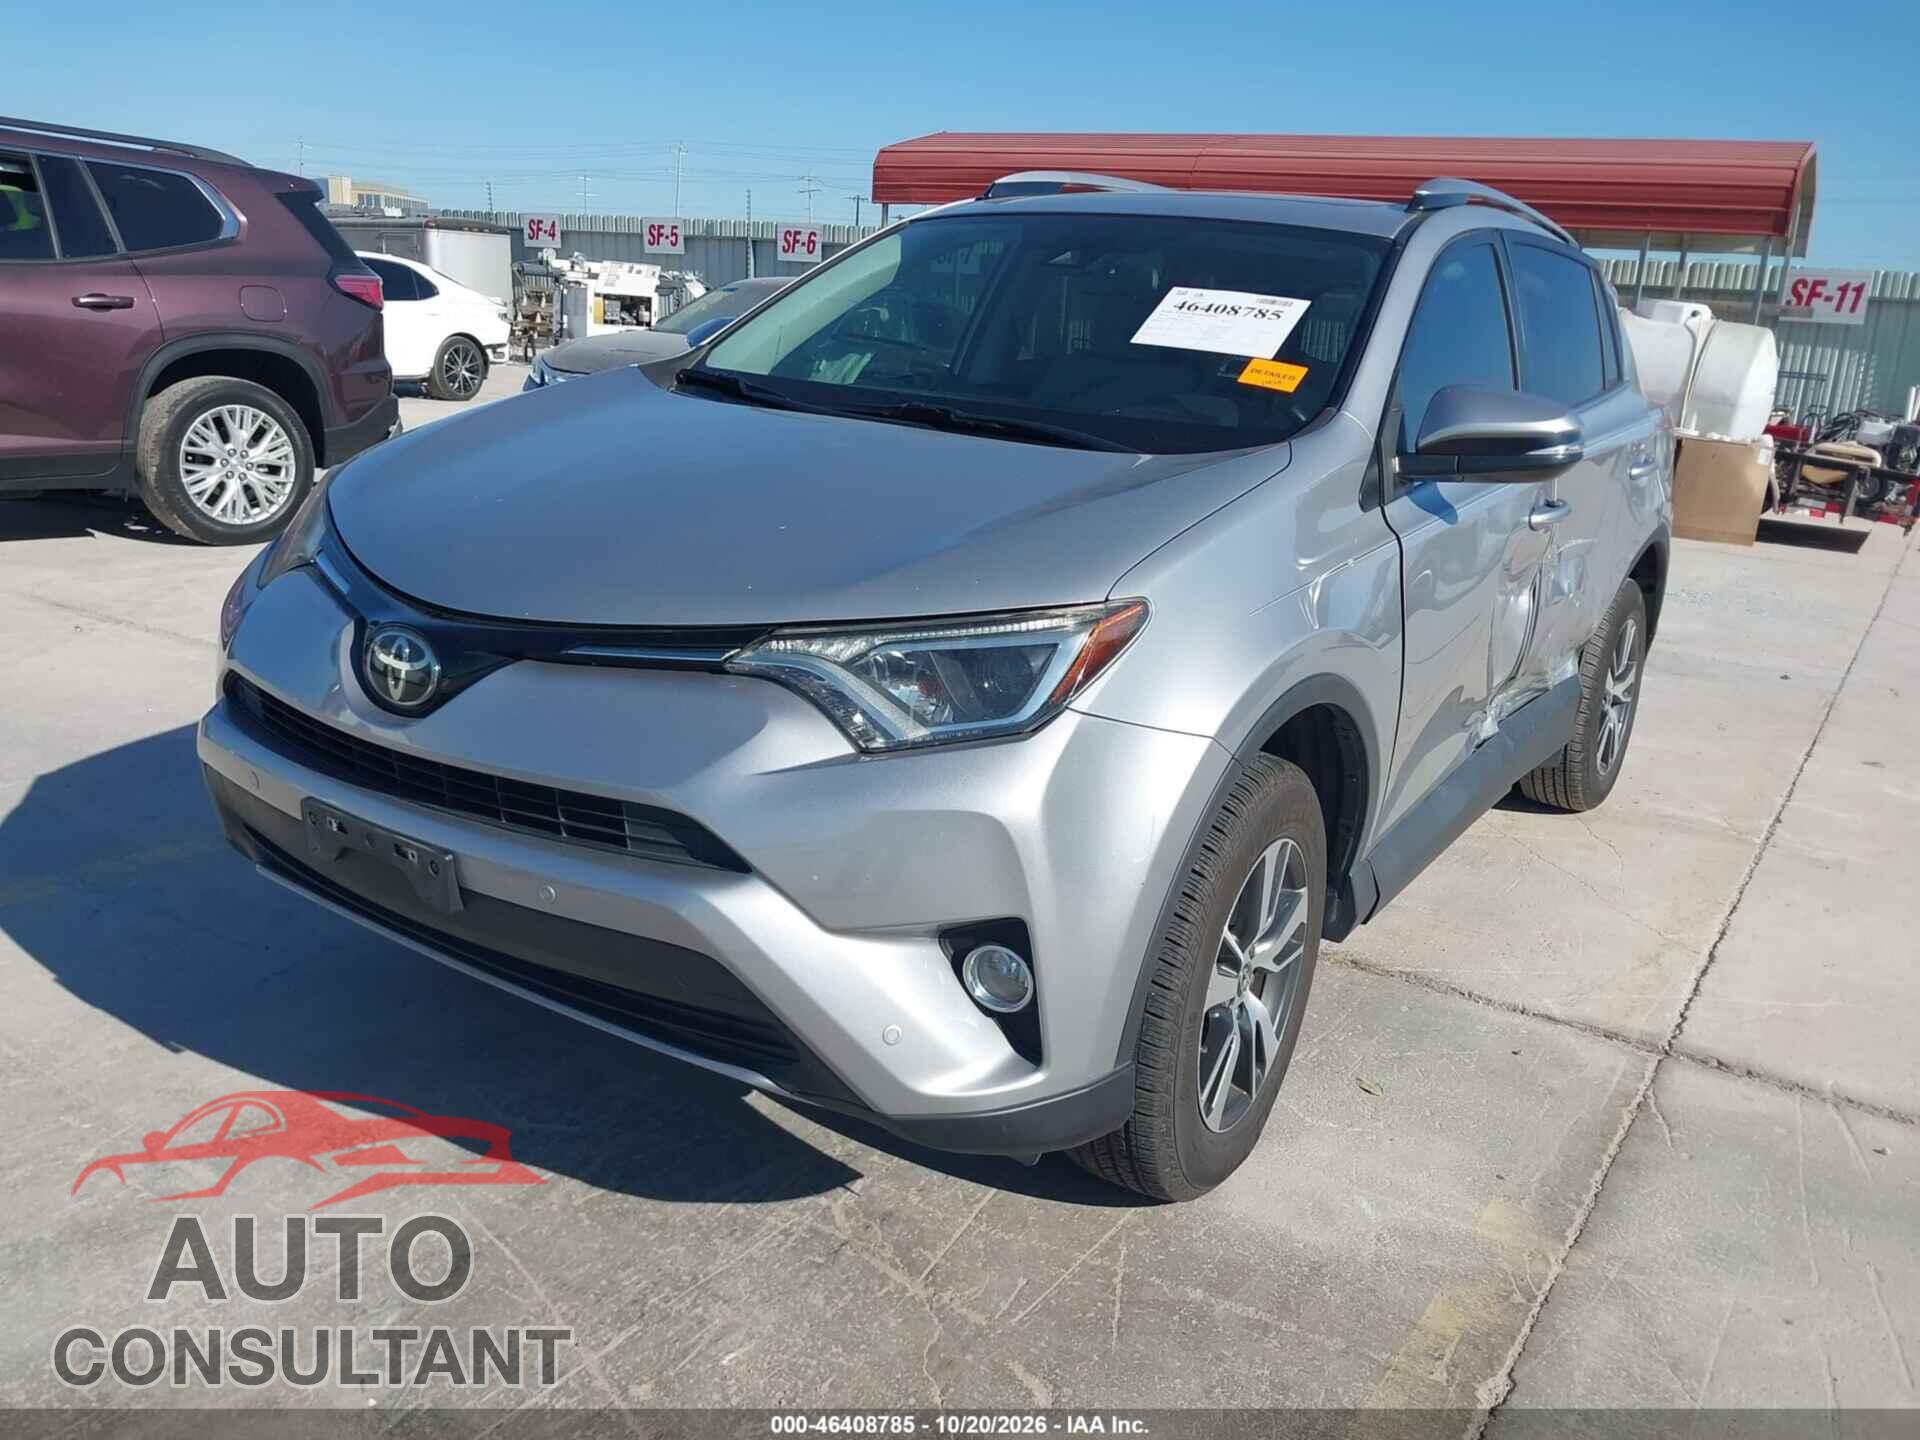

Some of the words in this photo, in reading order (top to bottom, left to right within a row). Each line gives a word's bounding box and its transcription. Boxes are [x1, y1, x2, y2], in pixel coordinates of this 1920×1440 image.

[527, 218, 556, 241] SF-4
[647, 223, 679, 247] SF-5
[782, 230, 817, 255] SF-6
[1785, 278, 1866, 314] SF-11
[1173, 300, 1285, 321] 46408785
